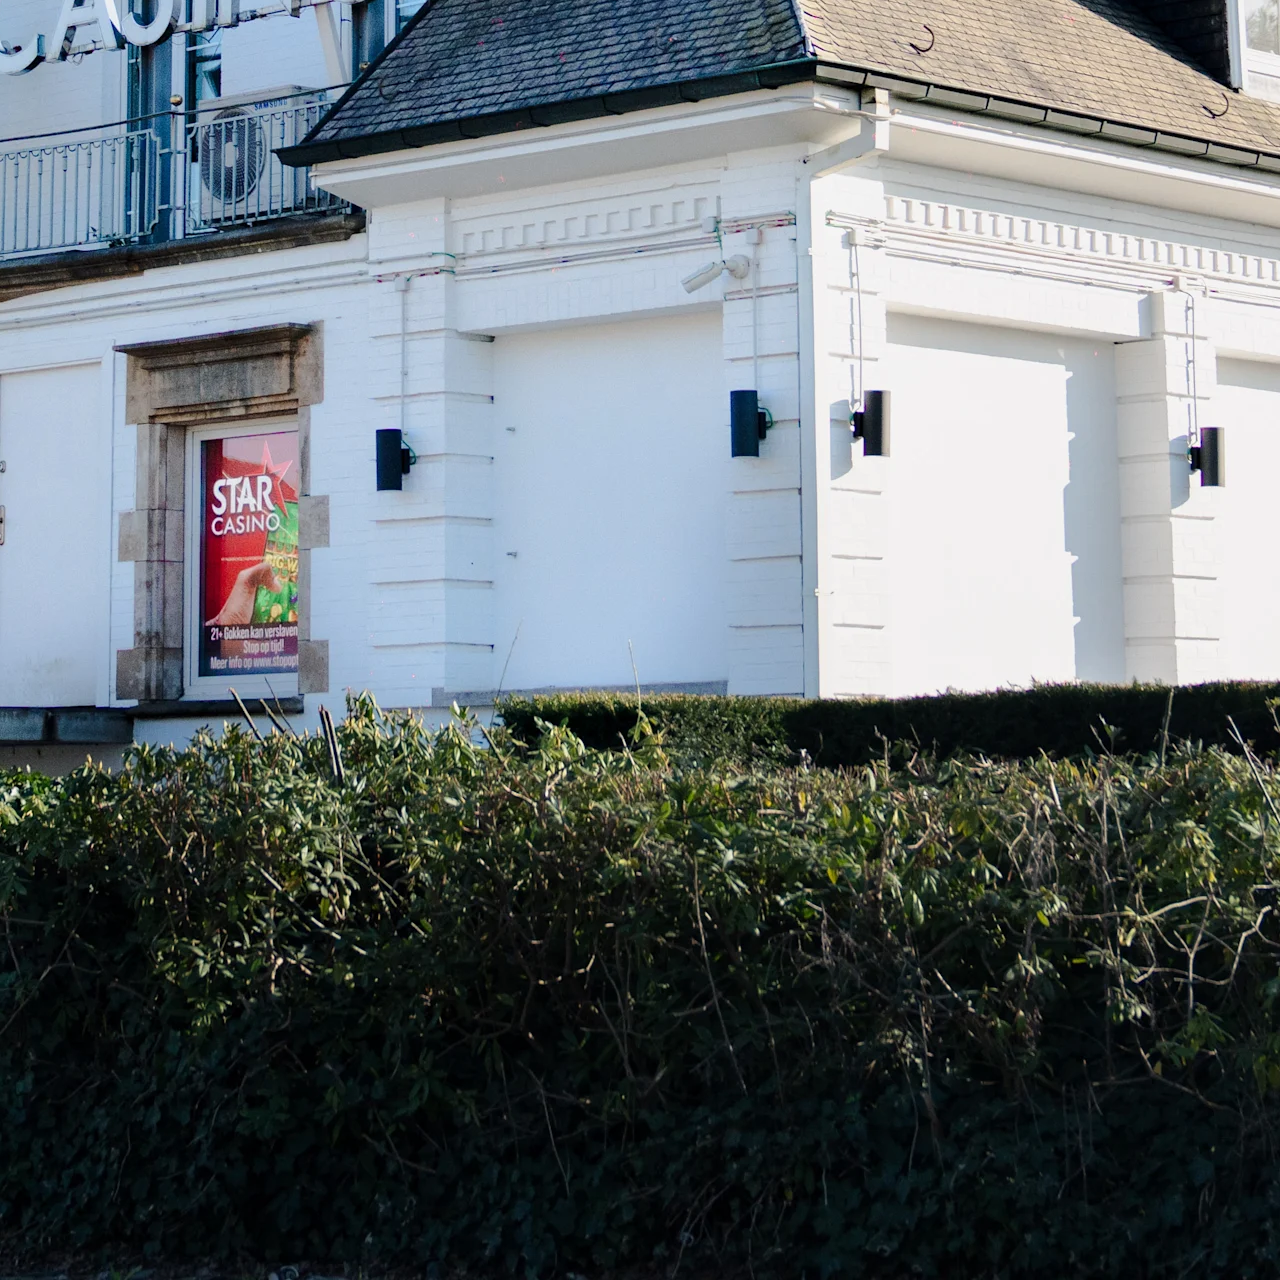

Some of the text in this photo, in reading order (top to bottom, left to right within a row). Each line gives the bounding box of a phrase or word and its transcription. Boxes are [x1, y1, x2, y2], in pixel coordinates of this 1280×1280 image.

[254, 99, 287, 110] SAMSUNG
[211, 475, 275, 515] STAR
[211, 513, 280, 536] CASINO
[211, 628, 223, 640] 21+
[224, 626, 249, 639] Gokken
[250, 626, 263, 638] kan
[243, 639, 284, 654] Stop op tijd!
[211, 657, 227, 669] Meer
[229, 656, 242, 668] info
[243, 658, 252, 670] op
